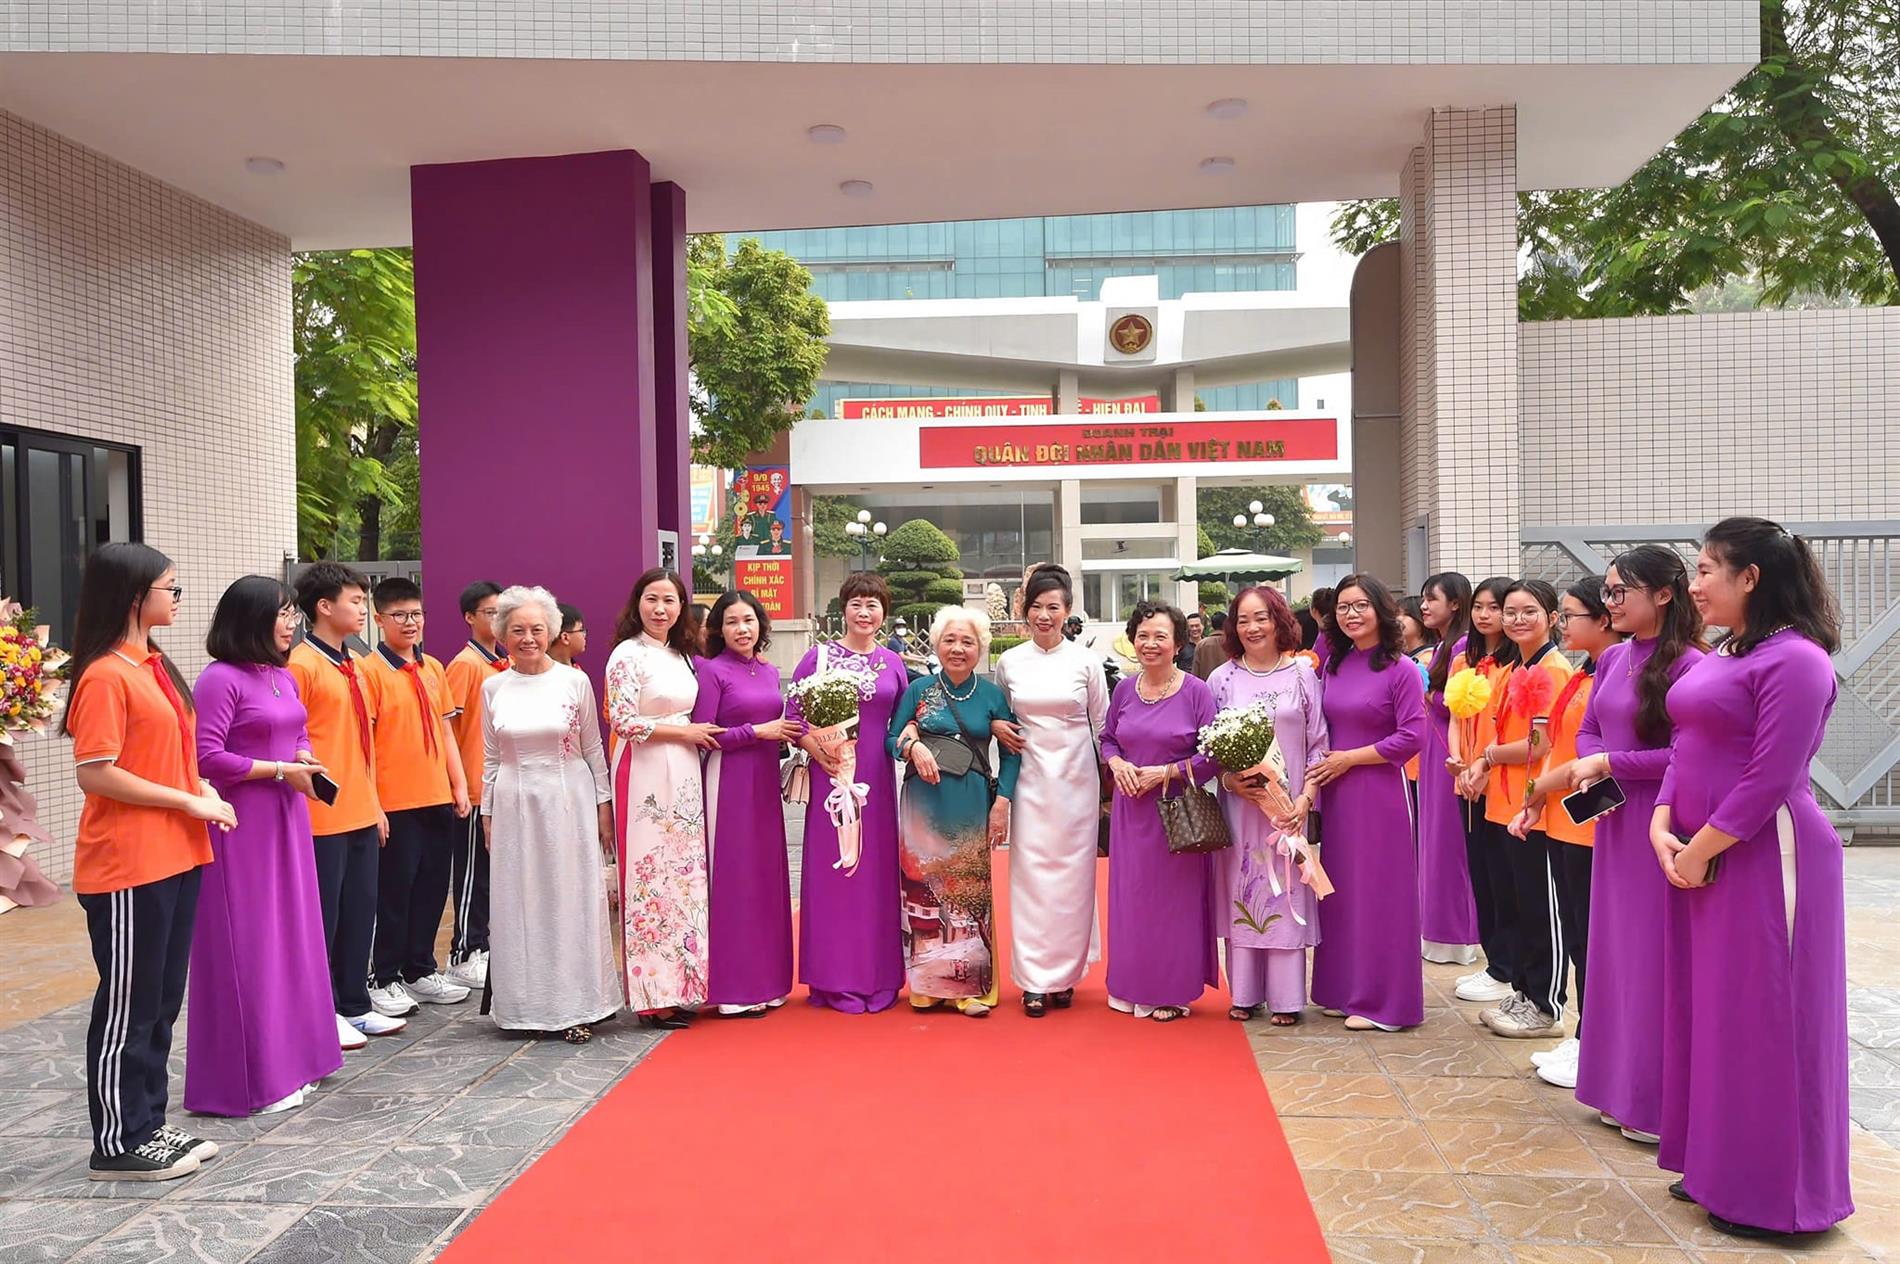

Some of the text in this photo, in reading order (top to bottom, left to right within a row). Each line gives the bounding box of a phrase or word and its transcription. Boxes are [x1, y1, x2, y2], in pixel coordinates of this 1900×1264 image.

[1035, 441, 1070, 466] ĐỘI
[1076, 440, 1133, 462] NHÂN
[1139, 439, 1182, 460] DÂN
[1187, 437, 1230, 462] VIỆT
[1236, 440, 1286, 459] NAM
[752, 484, 770, 492] 1945
[747, 561, 780, 573] KỊP THỜI
[743, 574, 785, 585] CHÍNH XÁC
[761, 587, 778, 600] MẬT
